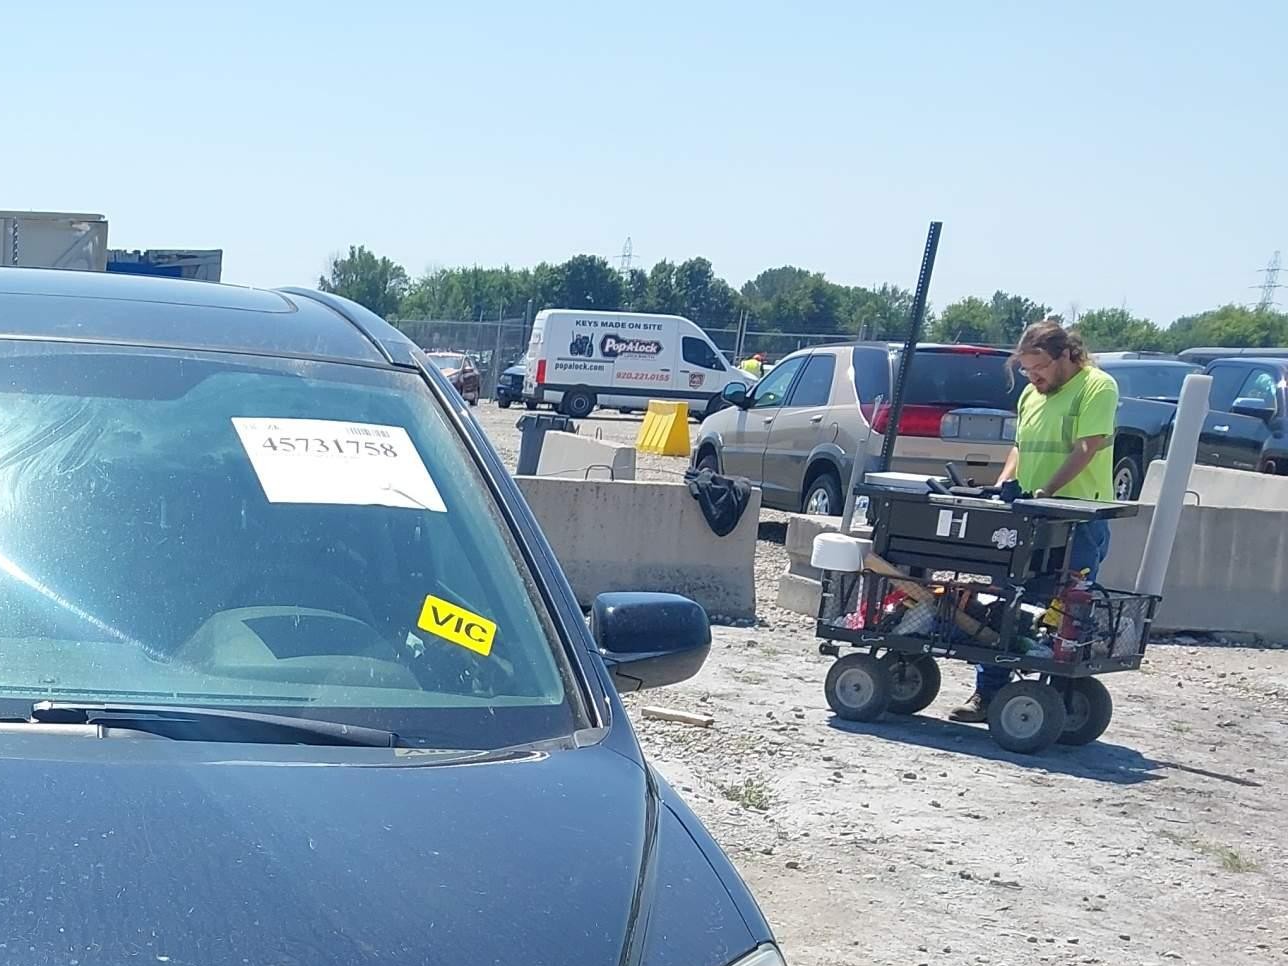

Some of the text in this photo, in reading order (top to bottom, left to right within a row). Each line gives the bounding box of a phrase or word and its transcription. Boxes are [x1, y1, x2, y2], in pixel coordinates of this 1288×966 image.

[576, 320, 663, 331] KEYS MADE ON SITE
[555, 362, 605, 371] popalock.com
[262, 436, 398, 458] 45731758
[431, 605, 488, 643] VIC
